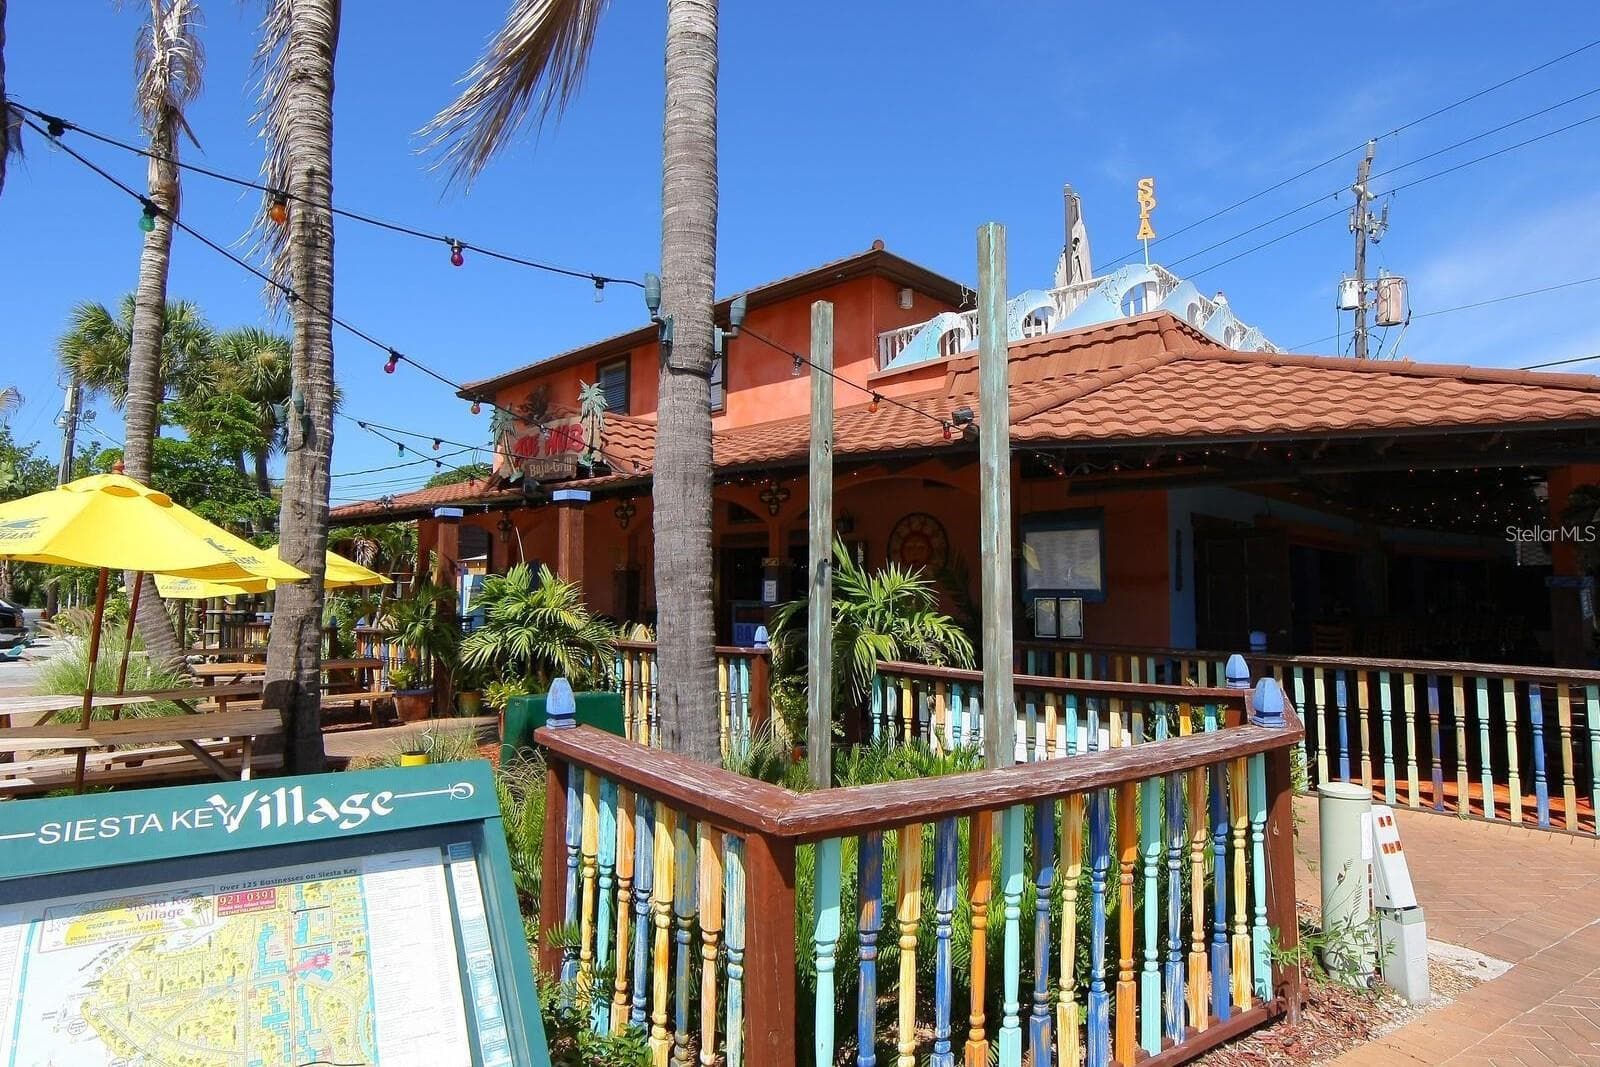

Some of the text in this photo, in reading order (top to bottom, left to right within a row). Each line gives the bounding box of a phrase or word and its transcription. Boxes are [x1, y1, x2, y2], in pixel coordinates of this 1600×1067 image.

[1136, 177, 1156, 240] SPA
[553, 456, 572, 472] Grill
[38, 785, 395, 845] SIESTA KEY Village
[219, 867, 358, 892] Over 125 Businesses on Siesta Key
[136, 907, 185, 922] Village
